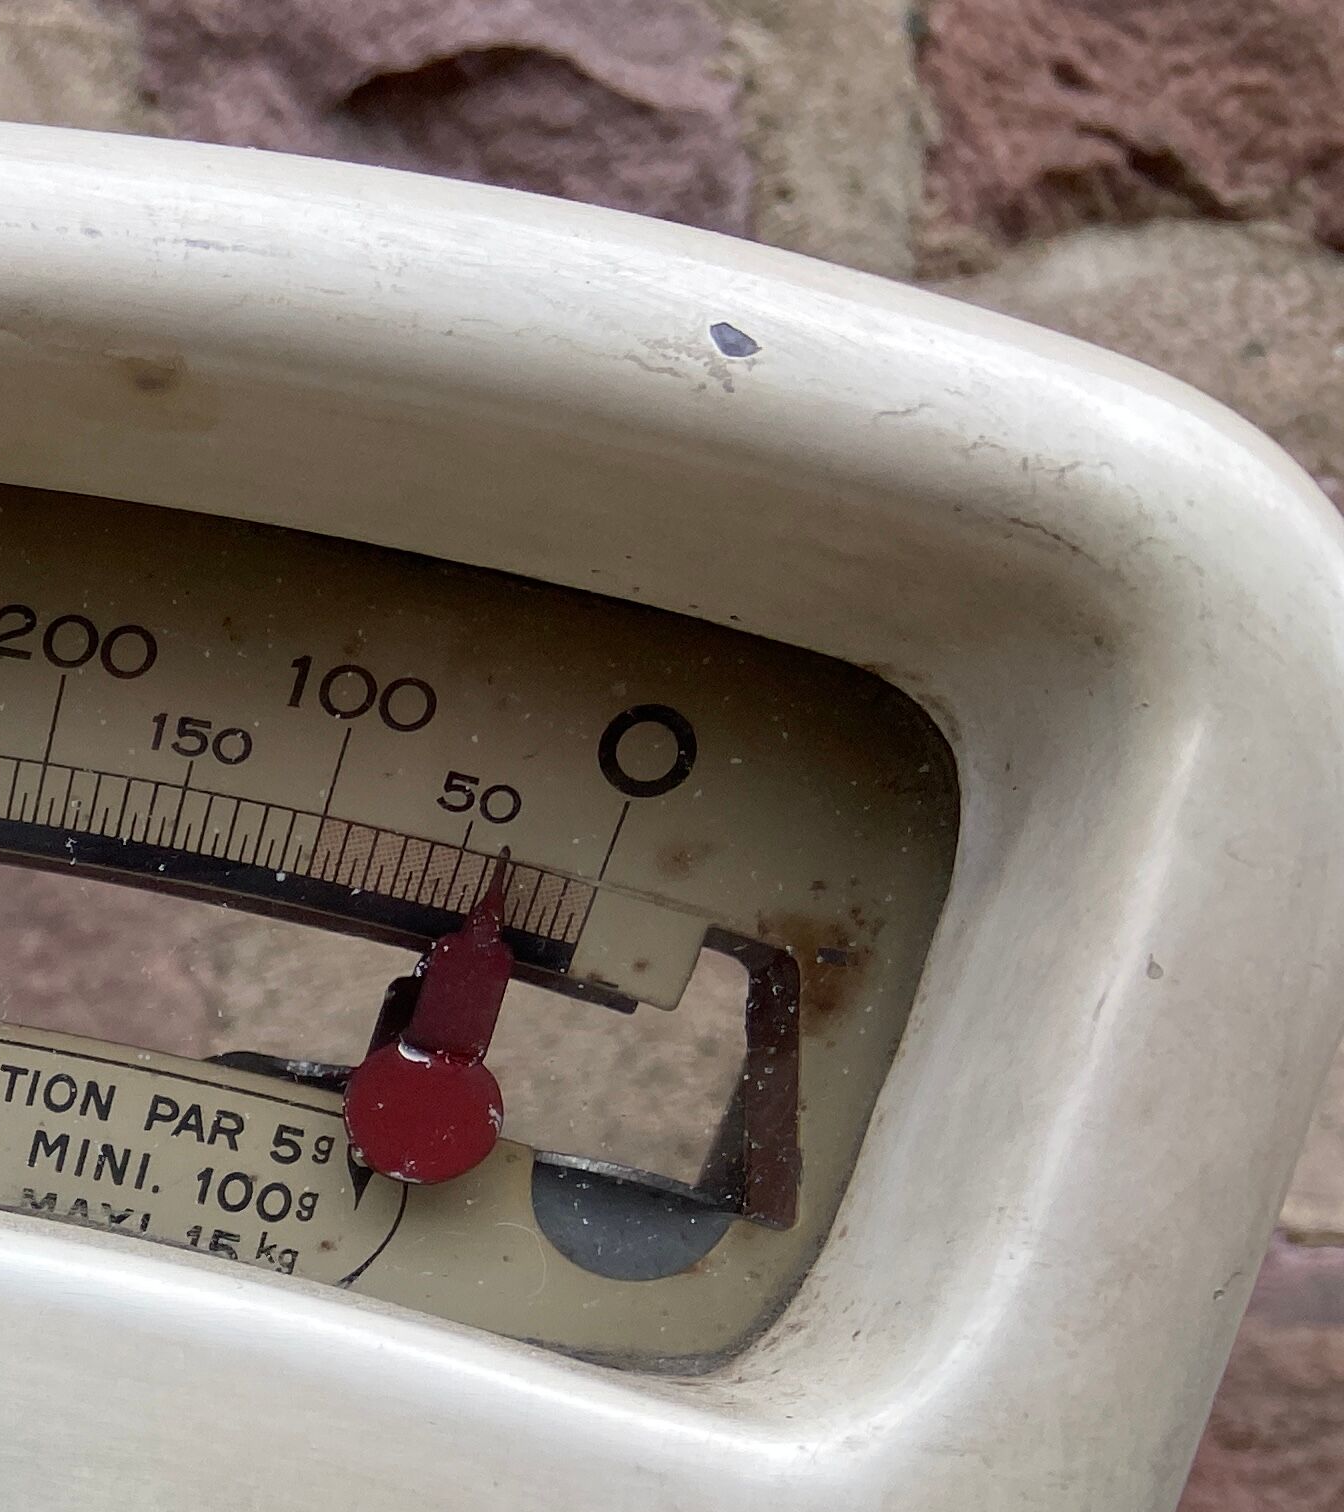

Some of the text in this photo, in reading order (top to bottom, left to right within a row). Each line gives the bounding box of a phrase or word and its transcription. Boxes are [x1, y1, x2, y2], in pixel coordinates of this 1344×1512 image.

[150, 712, 253, 765] 150
[436, 769, 522, 825] 50
[286, 655, 437, 732] 100
[598, 703, 698, 798] 0
[145, 1094, 245, 1152] PAR
[27, 1128, 160, 1195] MINI.
[196, 1167, 320, 1223] 100g
